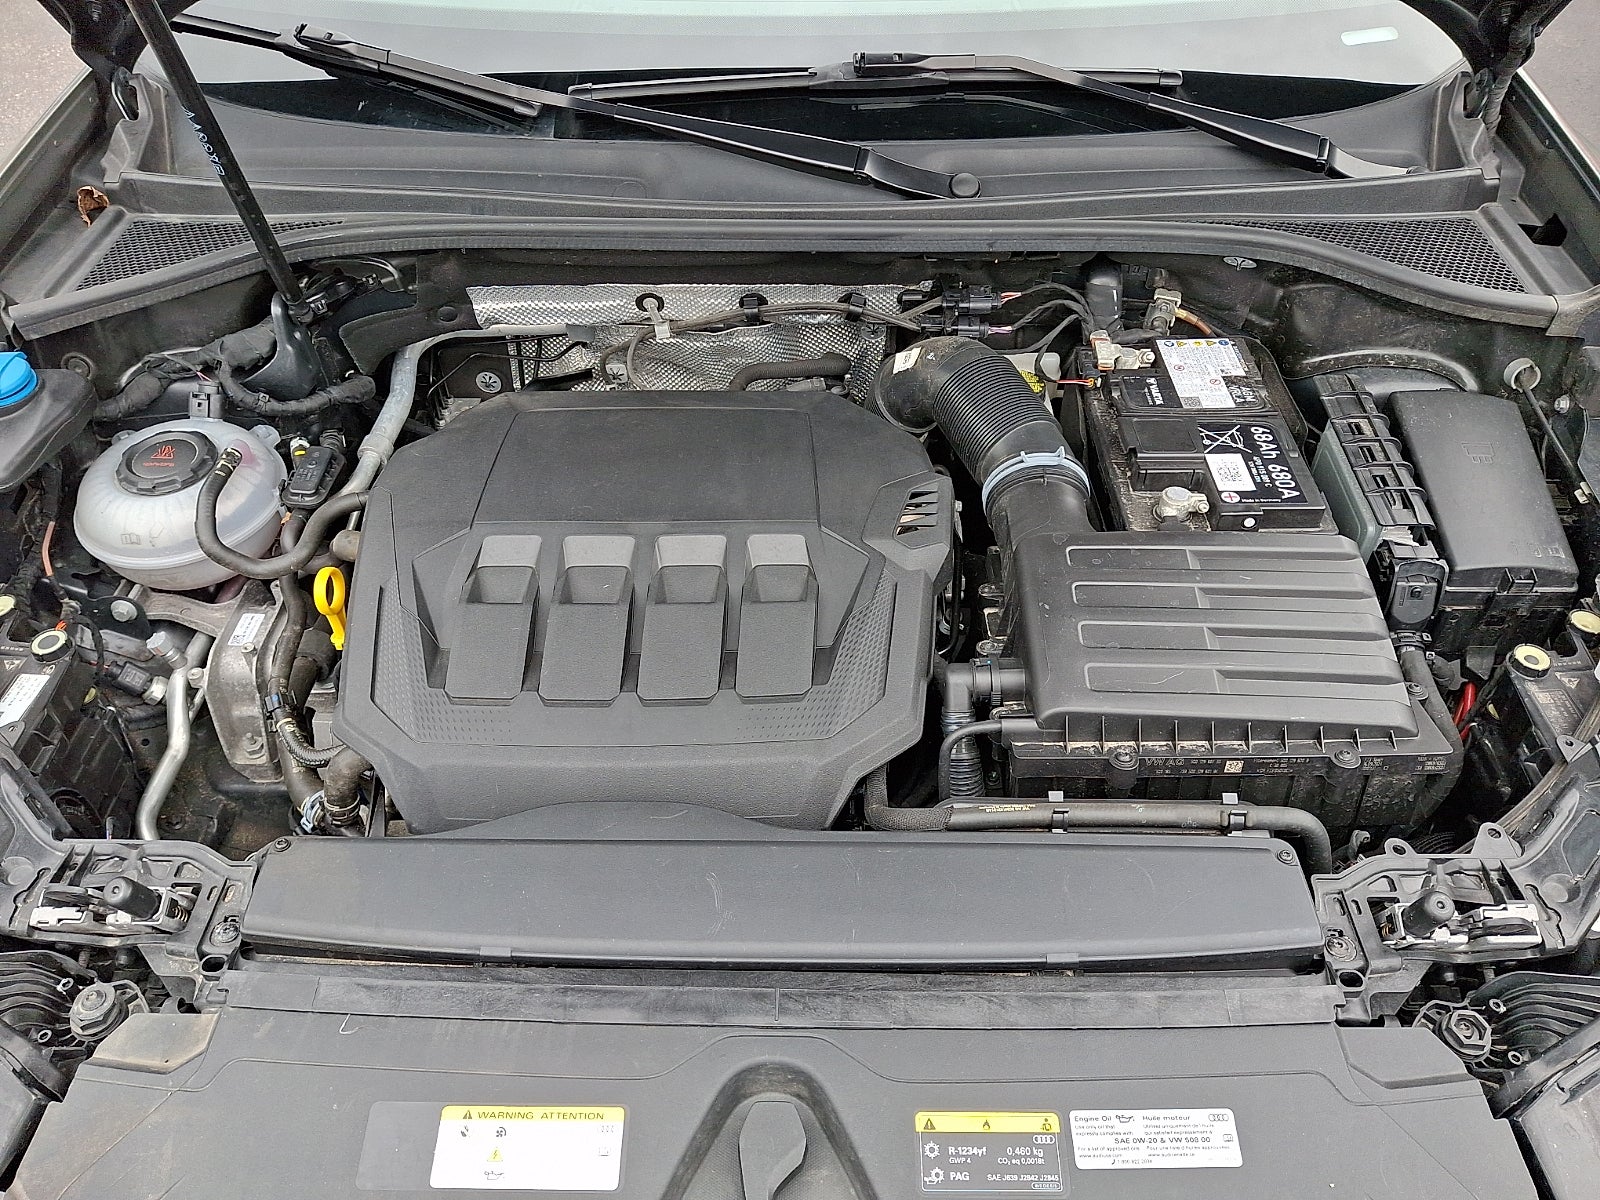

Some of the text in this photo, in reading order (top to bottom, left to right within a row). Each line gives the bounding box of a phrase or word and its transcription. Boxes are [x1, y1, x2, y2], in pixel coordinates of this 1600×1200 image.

[1240, 386, 1256, 402] AGM
[1250, 426, 1280, 459] 68Ah
[1267, 464, 1300, 499] 680A
[477, 1111, 604, 1120] WARNING ATTENTION
[948, 1146, 1044, 1157] R-1234yf 0,460 kg
[950, 1171, 970, 1180] PAG
